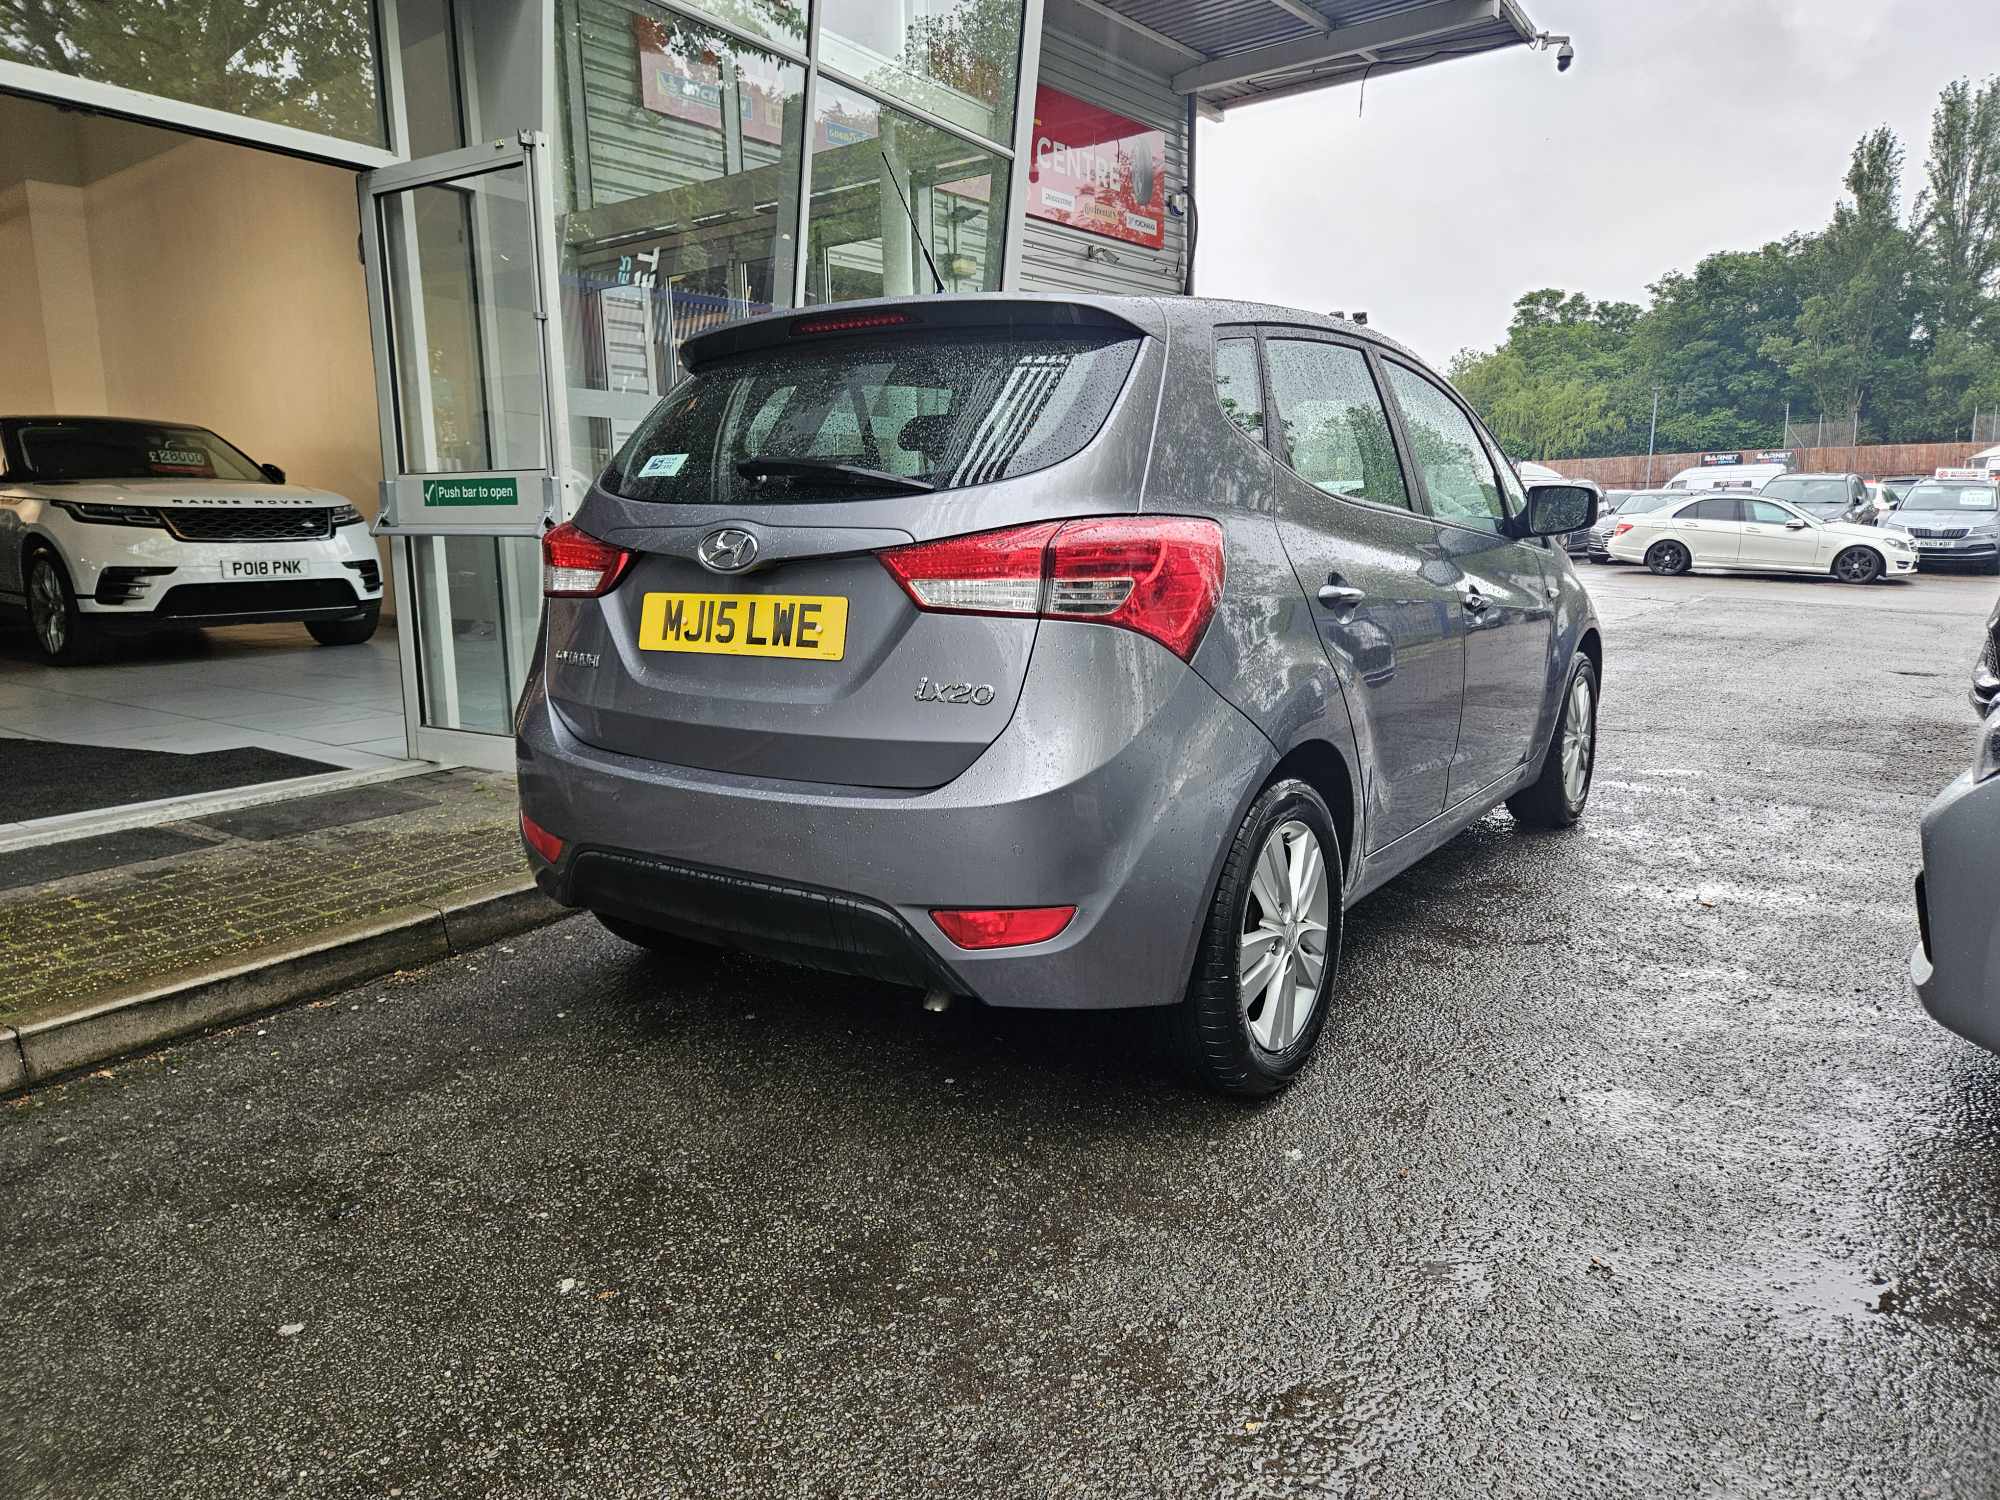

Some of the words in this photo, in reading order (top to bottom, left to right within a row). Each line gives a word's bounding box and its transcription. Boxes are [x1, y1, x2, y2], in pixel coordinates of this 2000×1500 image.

[1037, 136, 1121, 193] CENTRE
[438, 486, 460, 499] Push
[462, 486, 477, 498] bar
[479, 486, 488, 498] to
[490, 487, 513, 500] open
[232, 562, 268, 576] PO18
[273, 560, 302, 575] PNK
[661, 600, 738, 643] MJ15
[746, 602, 822, 648] LWE
